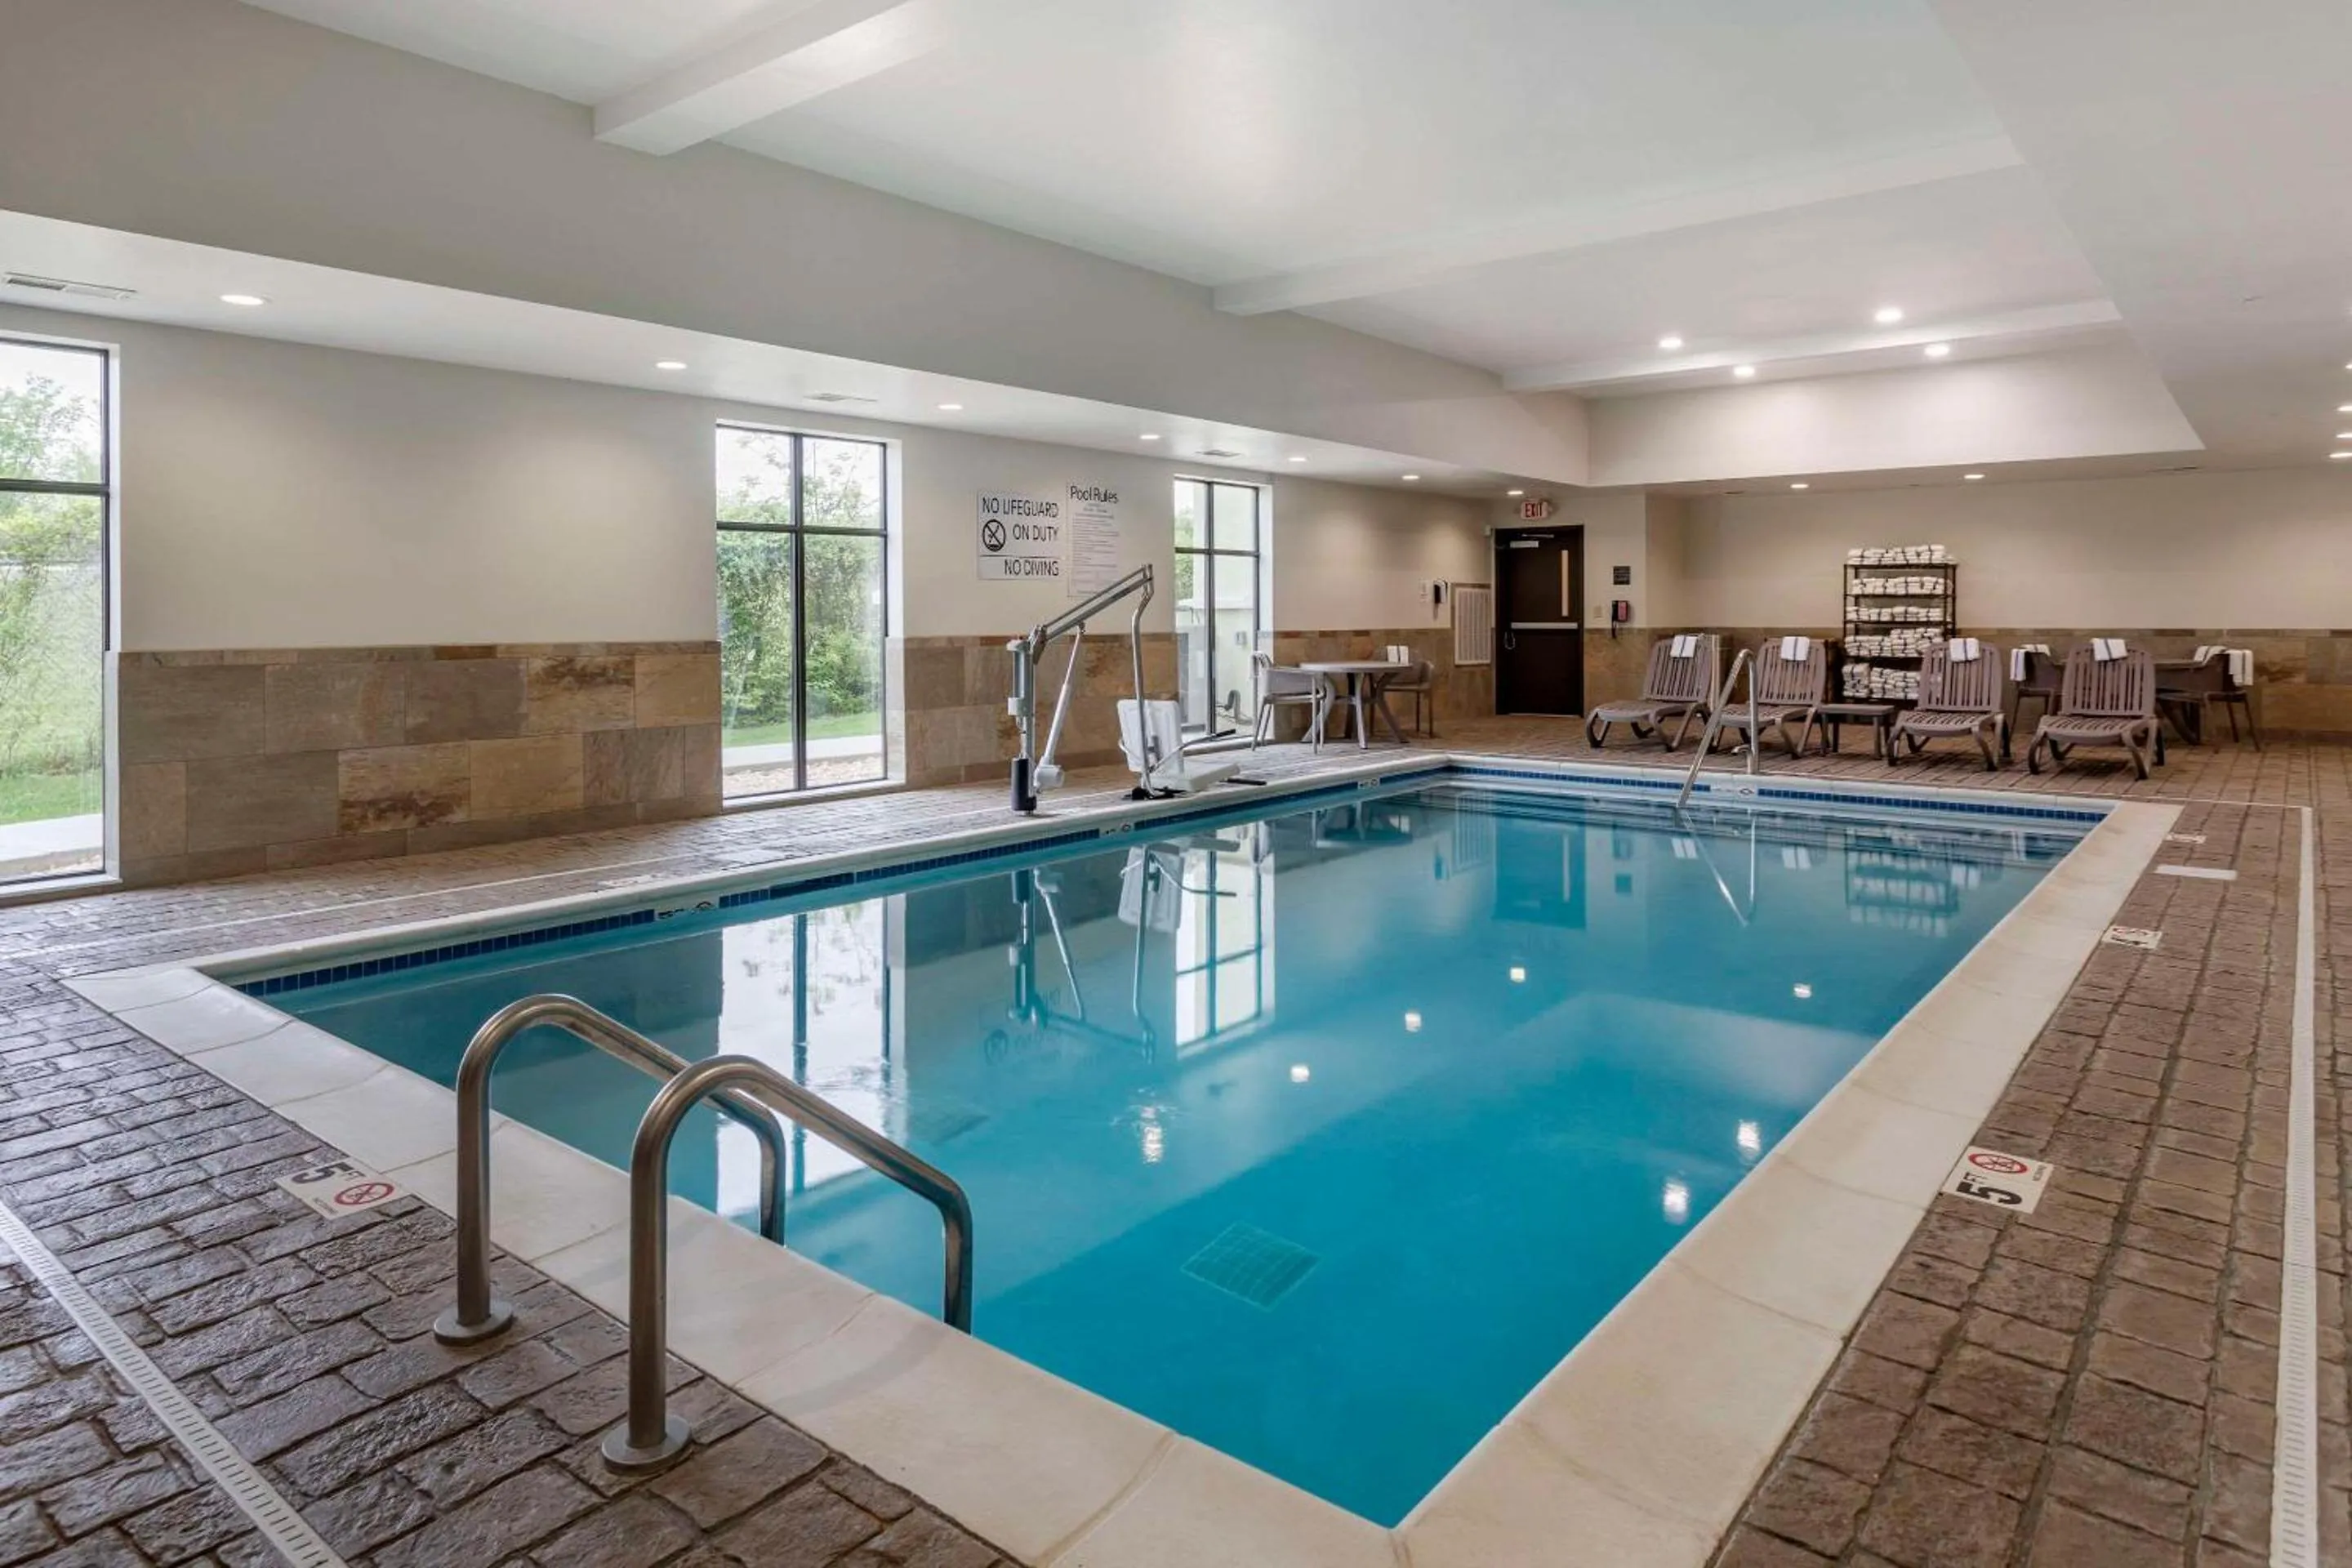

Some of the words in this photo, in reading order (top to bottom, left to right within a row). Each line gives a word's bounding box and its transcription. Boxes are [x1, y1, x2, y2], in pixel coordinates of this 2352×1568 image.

[1070, 485, 1092, 501] Pool
[1094, 487, 1120, 504] Rules
[982, 497, 1000, 514] NO
[1003, 498, 1059, 518] LIFEGUARD
[1525, 502, 1543, 518] EXIT
[1013, 523, 1030, 541] ON
[1032, 524, 1059, 542] DUTY
[1004, 559, 1022, 576] NO
[1023, 560, 1059, 577] DIVING
[291, 1161, 354, 1184] 5
[1956, 1181, 2023, 1205] 5
